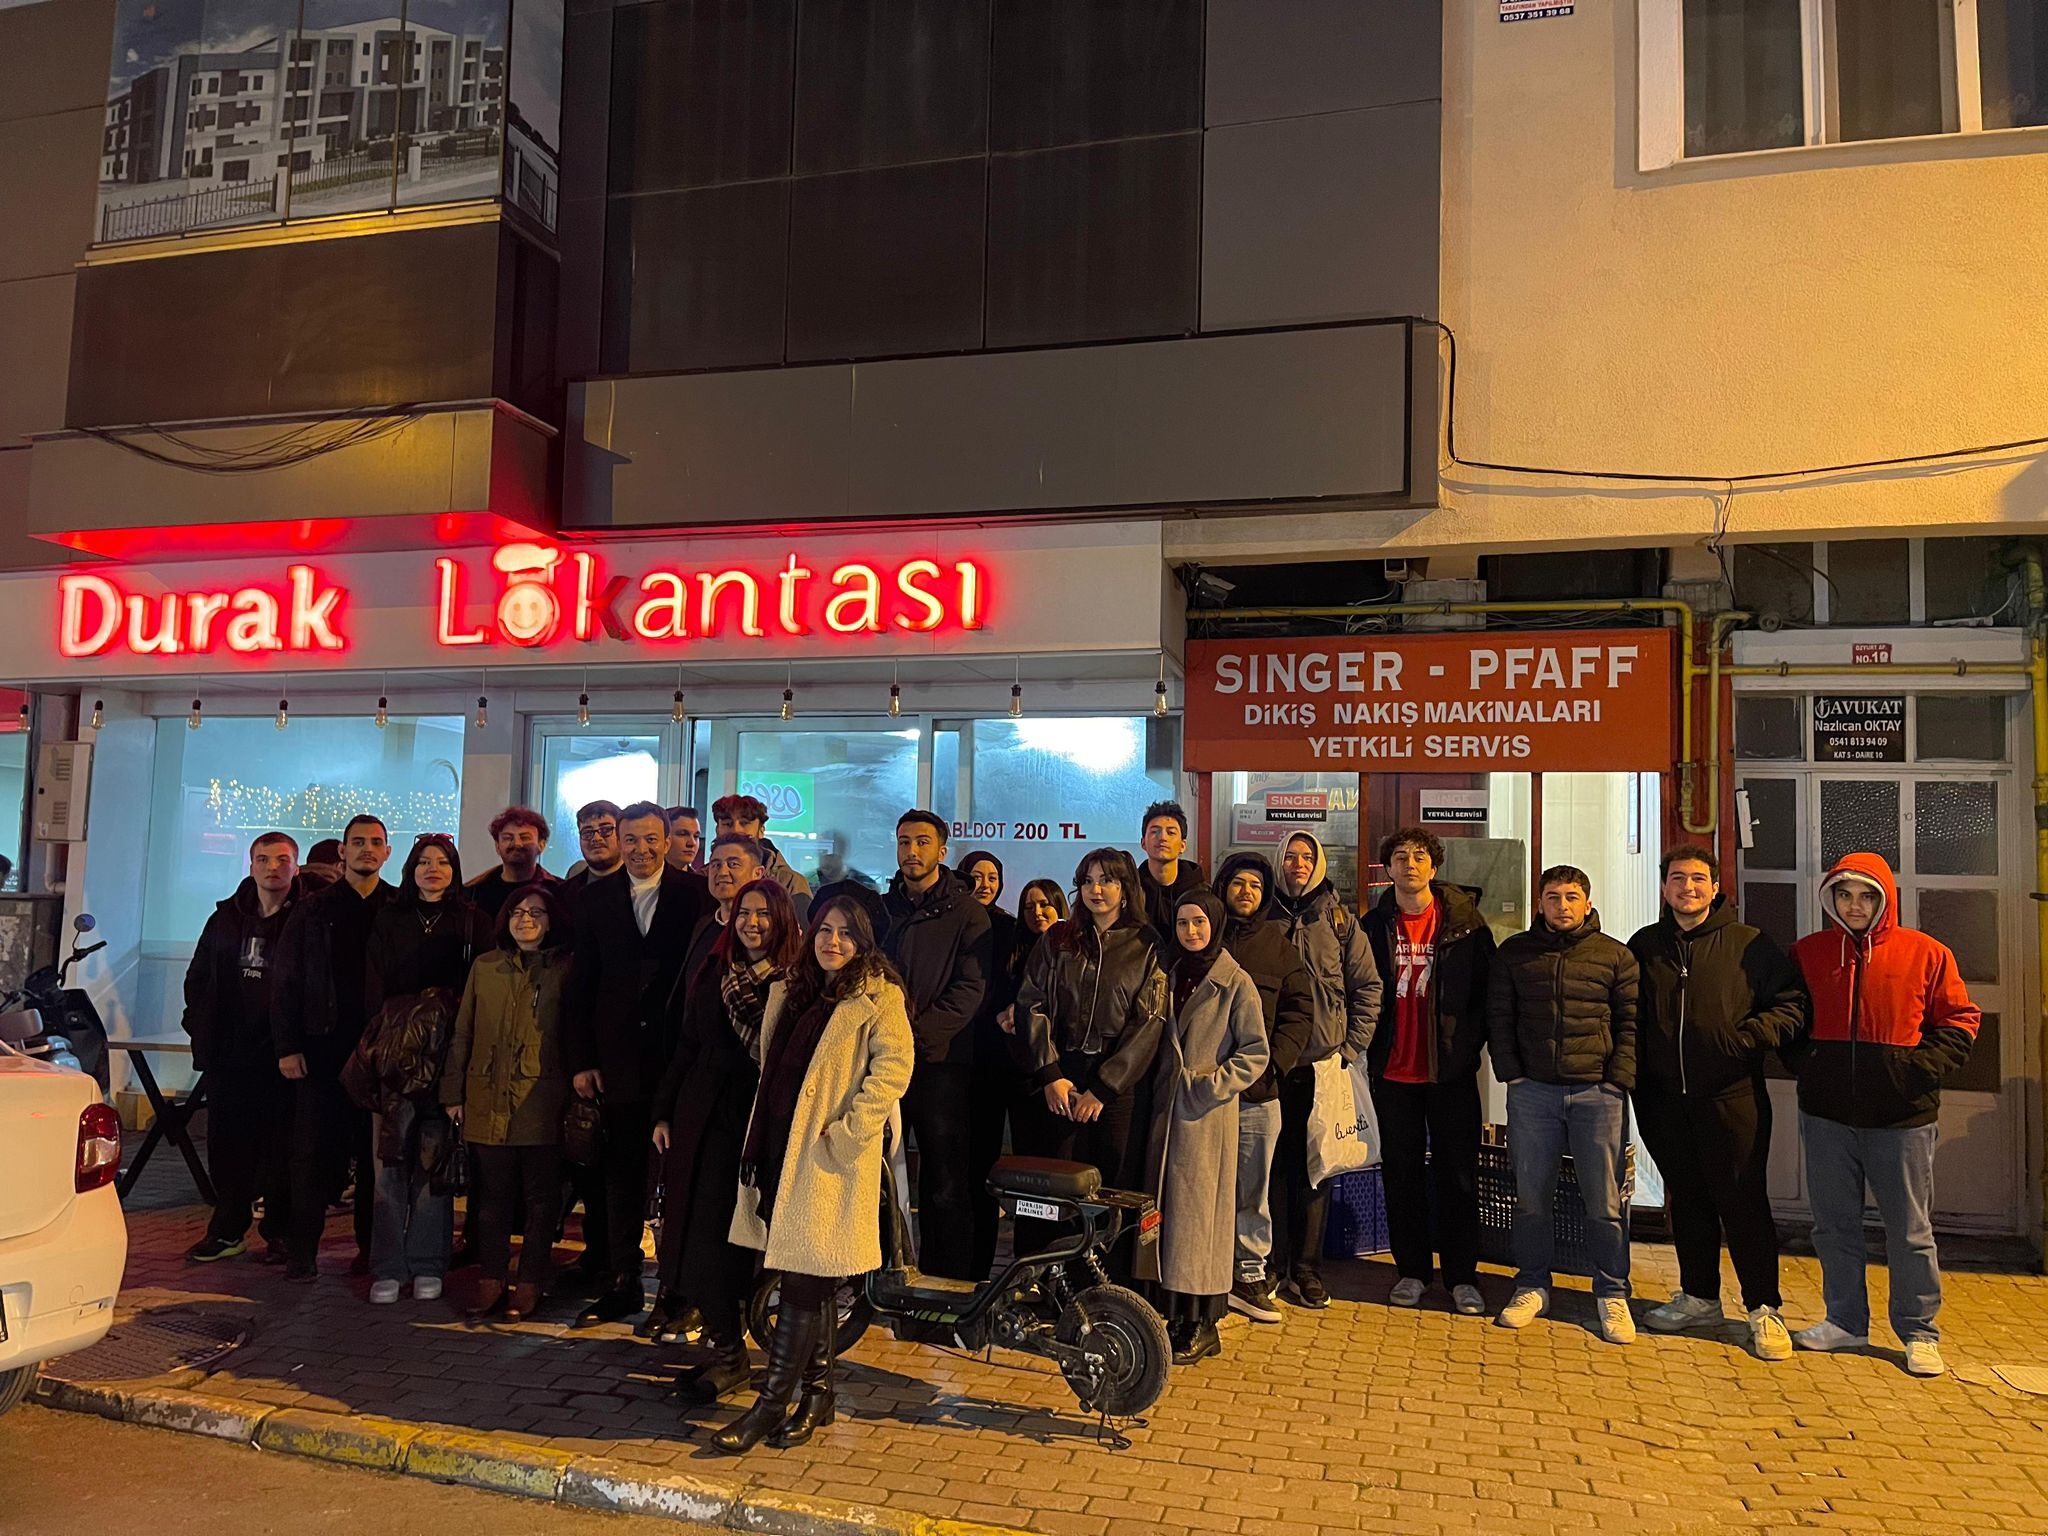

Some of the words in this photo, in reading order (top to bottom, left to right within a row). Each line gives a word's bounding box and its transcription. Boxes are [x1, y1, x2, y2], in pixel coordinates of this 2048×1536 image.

[59, 565, 344, 657] Durak
[1214, 651, 1403, 693] SINGER
[1469, 645, 1639, 691] PFAFF
[1244, 702, 1317, 728] DİKİŞ
[1333, 701, 1419, 728] NAKIŞ
[1424, 699, 1601, 724] MAKİNALARI
[1830, 700, 1903, 715] AVUKAT
[1815, 719, 1862, 732] Nazlıcan
[1864, 719, 1902, 732] OKTAY
[1308, 736, 1413, 759] YETKİLİ
[1424, 734, 1531, 758] SERVİS
[1829, 737, 1848, 746] 0541
[1850, 737, 1865, 746] 813
[1866, 737, 1876, 746] 94
[1877, 737, 1888, 746] 09
[1833, 751, 1846, 759] KAT
[1875, 751, 1884, 759] 10
[1271, 795, 1321, 806] SINGER
[1427, 809, 1454, 818] YETKİLİ
[1014, 823, 1048, 840] 200
[1059, 823, 1087, 839] TL
[1396, 943, 1434, 954] ARHIVE
[1395, 955, 1434, 998] 77
[1018, 1207, 1043, 1216] AIRLINES
[1019, 1201, 1043, 1210] TURKISH
